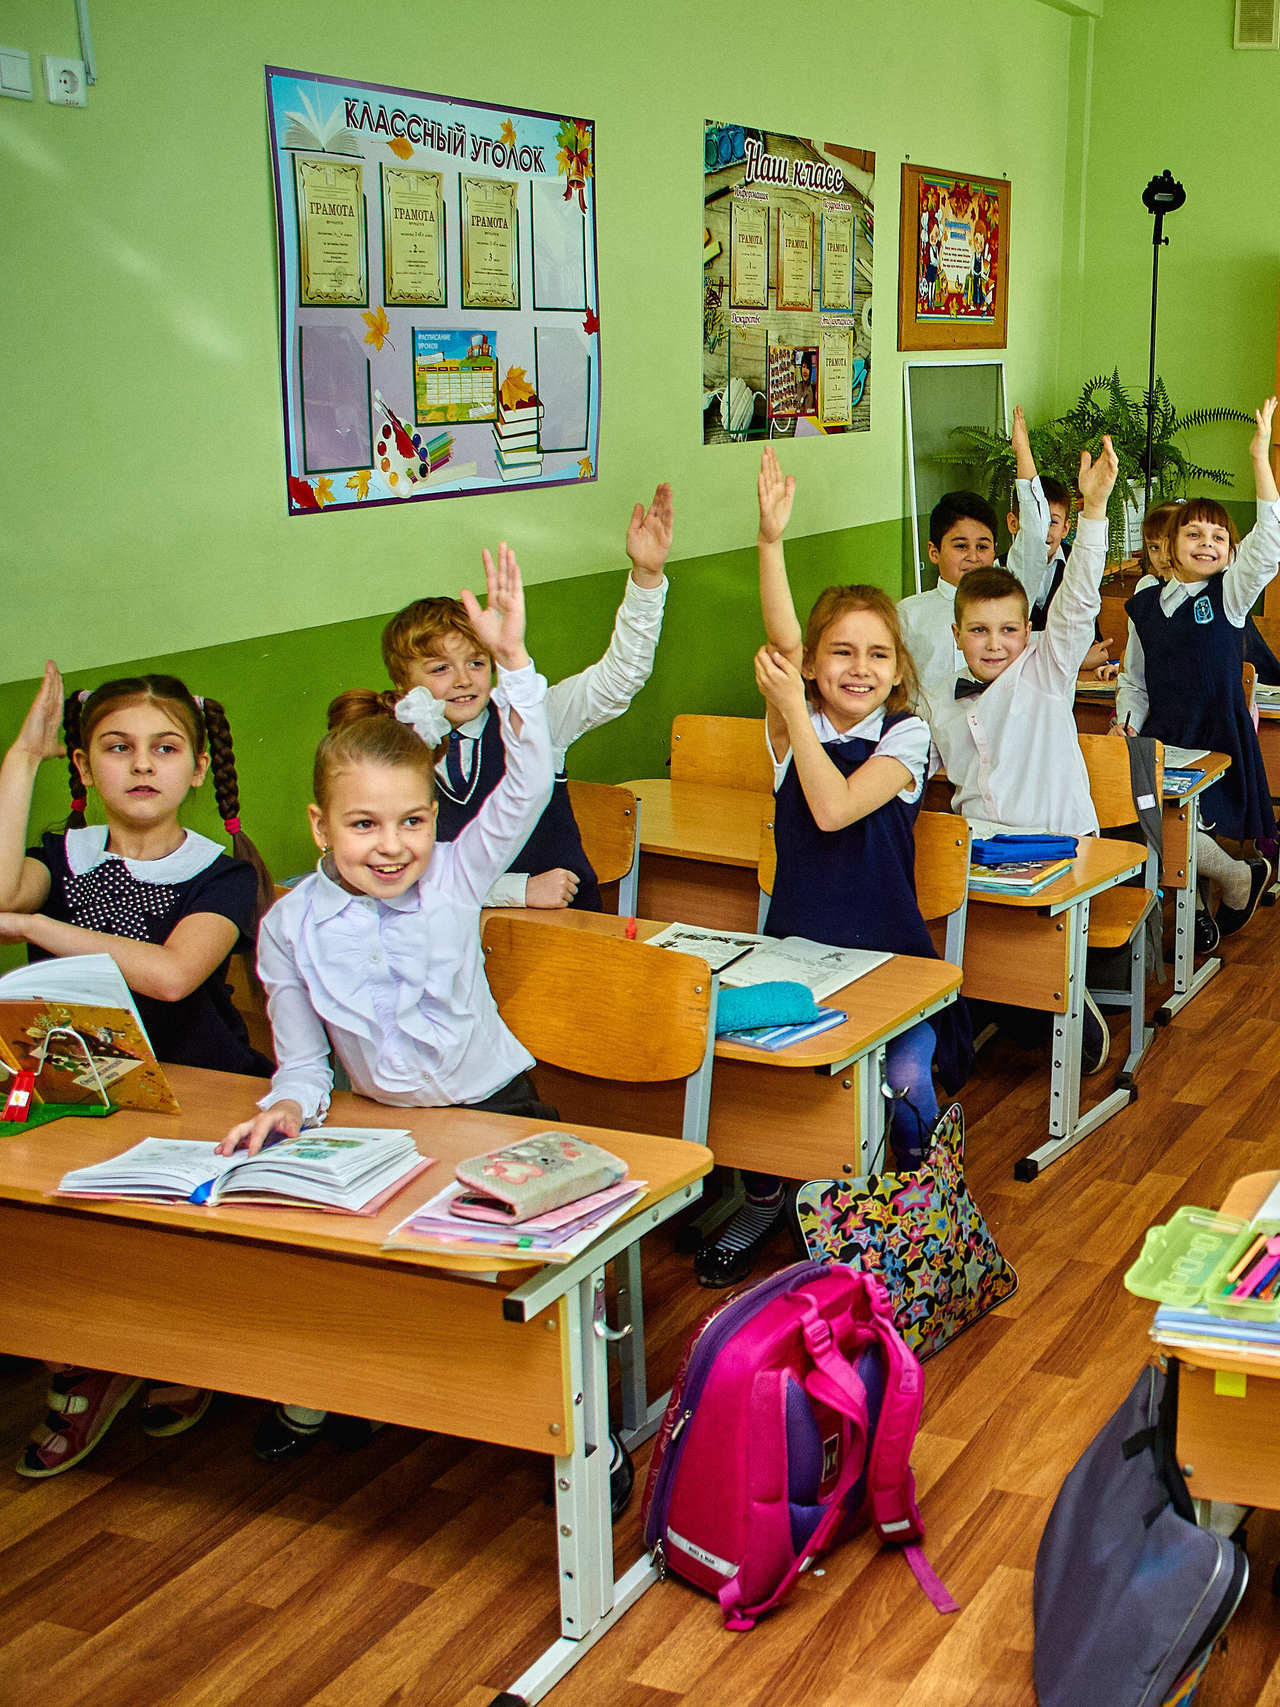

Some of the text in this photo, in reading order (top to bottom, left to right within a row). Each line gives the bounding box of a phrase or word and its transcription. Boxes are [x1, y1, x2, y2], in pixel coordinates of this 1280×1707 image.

[344, 97, 546, 173] КЛАССНЫЙ УГОЛОК
[744, 137, 844, 194] Наш класс
[310, 202, 355, 217] ГРАМОТА
[394, 207, 435, 222] ГРАМОТА
[471, 215, 509, 229] ГРАМОТА
[738, 233, 763, 246] ГРАМОТА
[785, 238, 809, 250] ГРАМОТА
[827, 242, 848, 253] ГРАМОТА
[825, 357, 847, 367] ГРАМОТА
